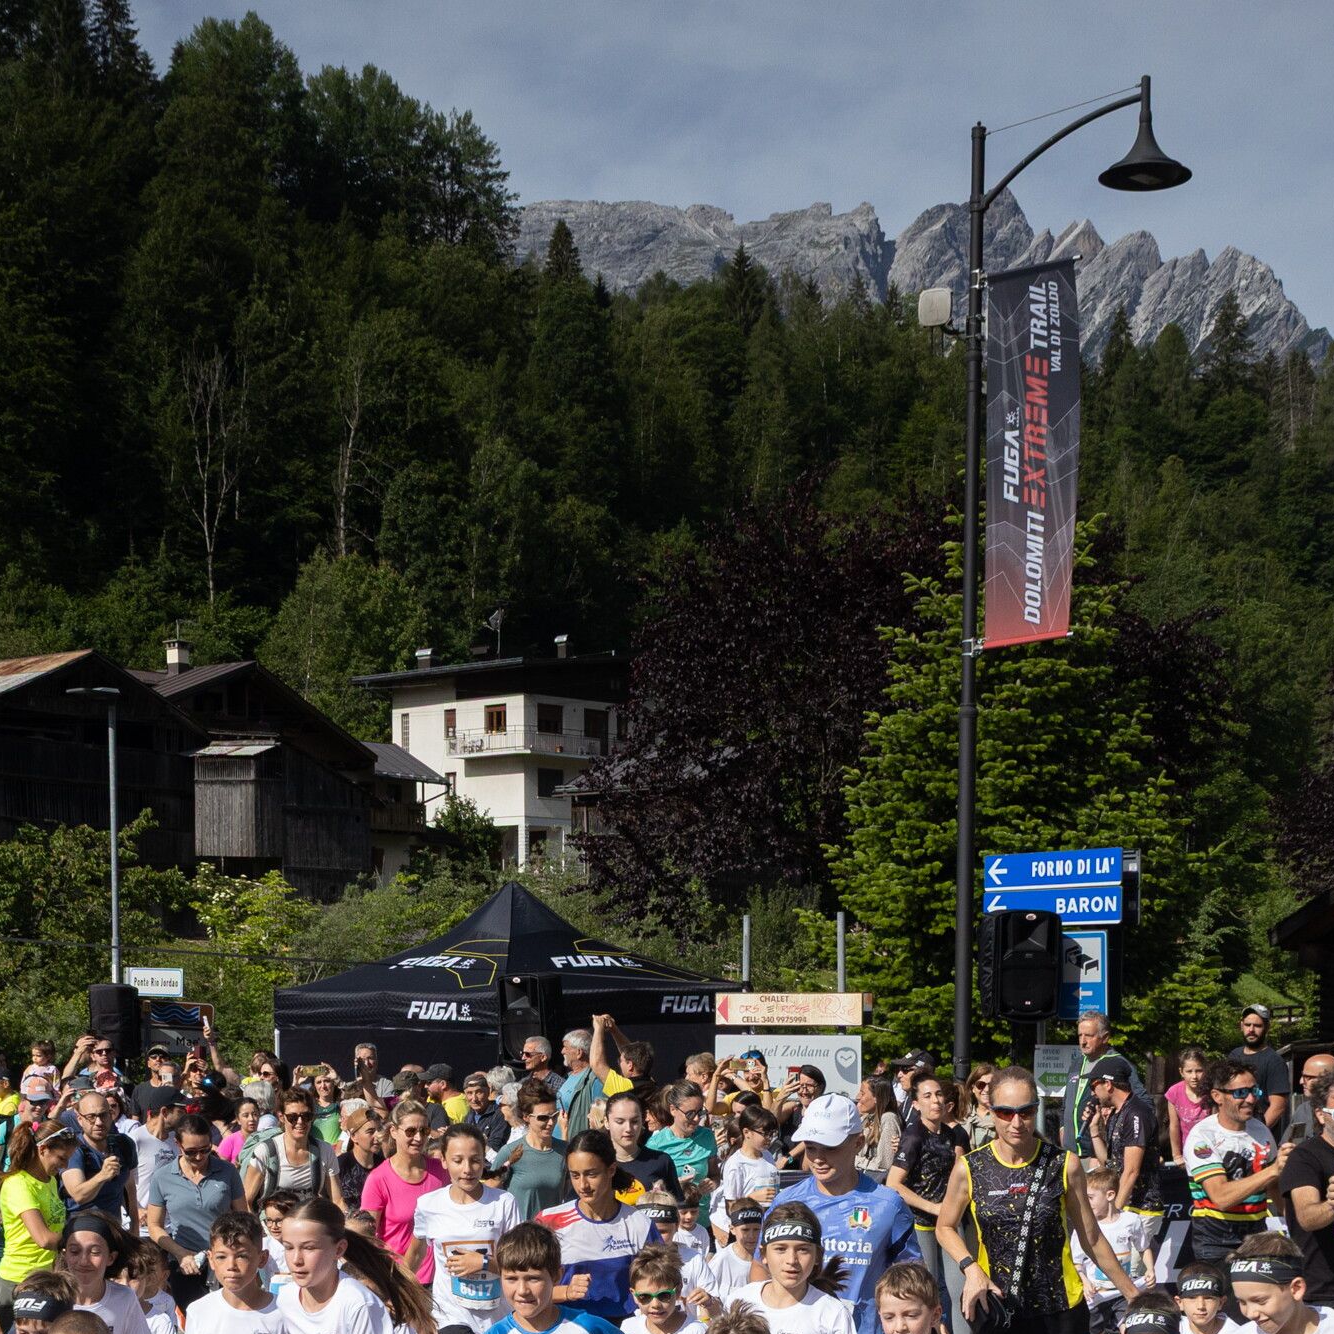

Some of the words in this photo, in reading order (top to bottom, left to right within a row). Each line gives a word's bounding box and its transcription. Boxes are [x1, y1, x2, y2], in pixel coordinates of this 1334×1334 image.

[1049, 281, 1059, 326] ZOLDO
[1029, 281, 1049, 350] TRAIL
[1051, 329, 1061, 342] DI
[1051, 343, 1061, 372] VAL
[1023, 353, 1049, 509] EXTREME
[1003, 430, 1020, 503] FUGA
[1023, 510, 1045, 625] DOLOMITI
[1031, 860, 1073, 878] FORNO
[1077, 858, 1091, 875] DI
[1095, 857, 1115, 874] LA'
[1055, 896, 1117, 914] BARON
[550, 956, 619, 969] FUGA
[133, 977, 149, 987] Ponte
[150, 977, 159, 987] Rio
[661, 995, 711, 1015] FUGA
[759, 995, 789, 1003] CHALET
[408, 1001, 458, 1021] FUGA
[761, 1016, 775, 1024] 340
[781, 1045, 830, 1058] Zoldana
[738, 1209, 762, 1220] FUGA
[764, 1225, 803, 1242] FUGA
[822, 1237, 873, 1253] ttoria
[460, 1281, 493, 1298] 6017
[1182, 1280, 1212, 1292] FUGA
[13, 1298, 47, 1311] FUG
